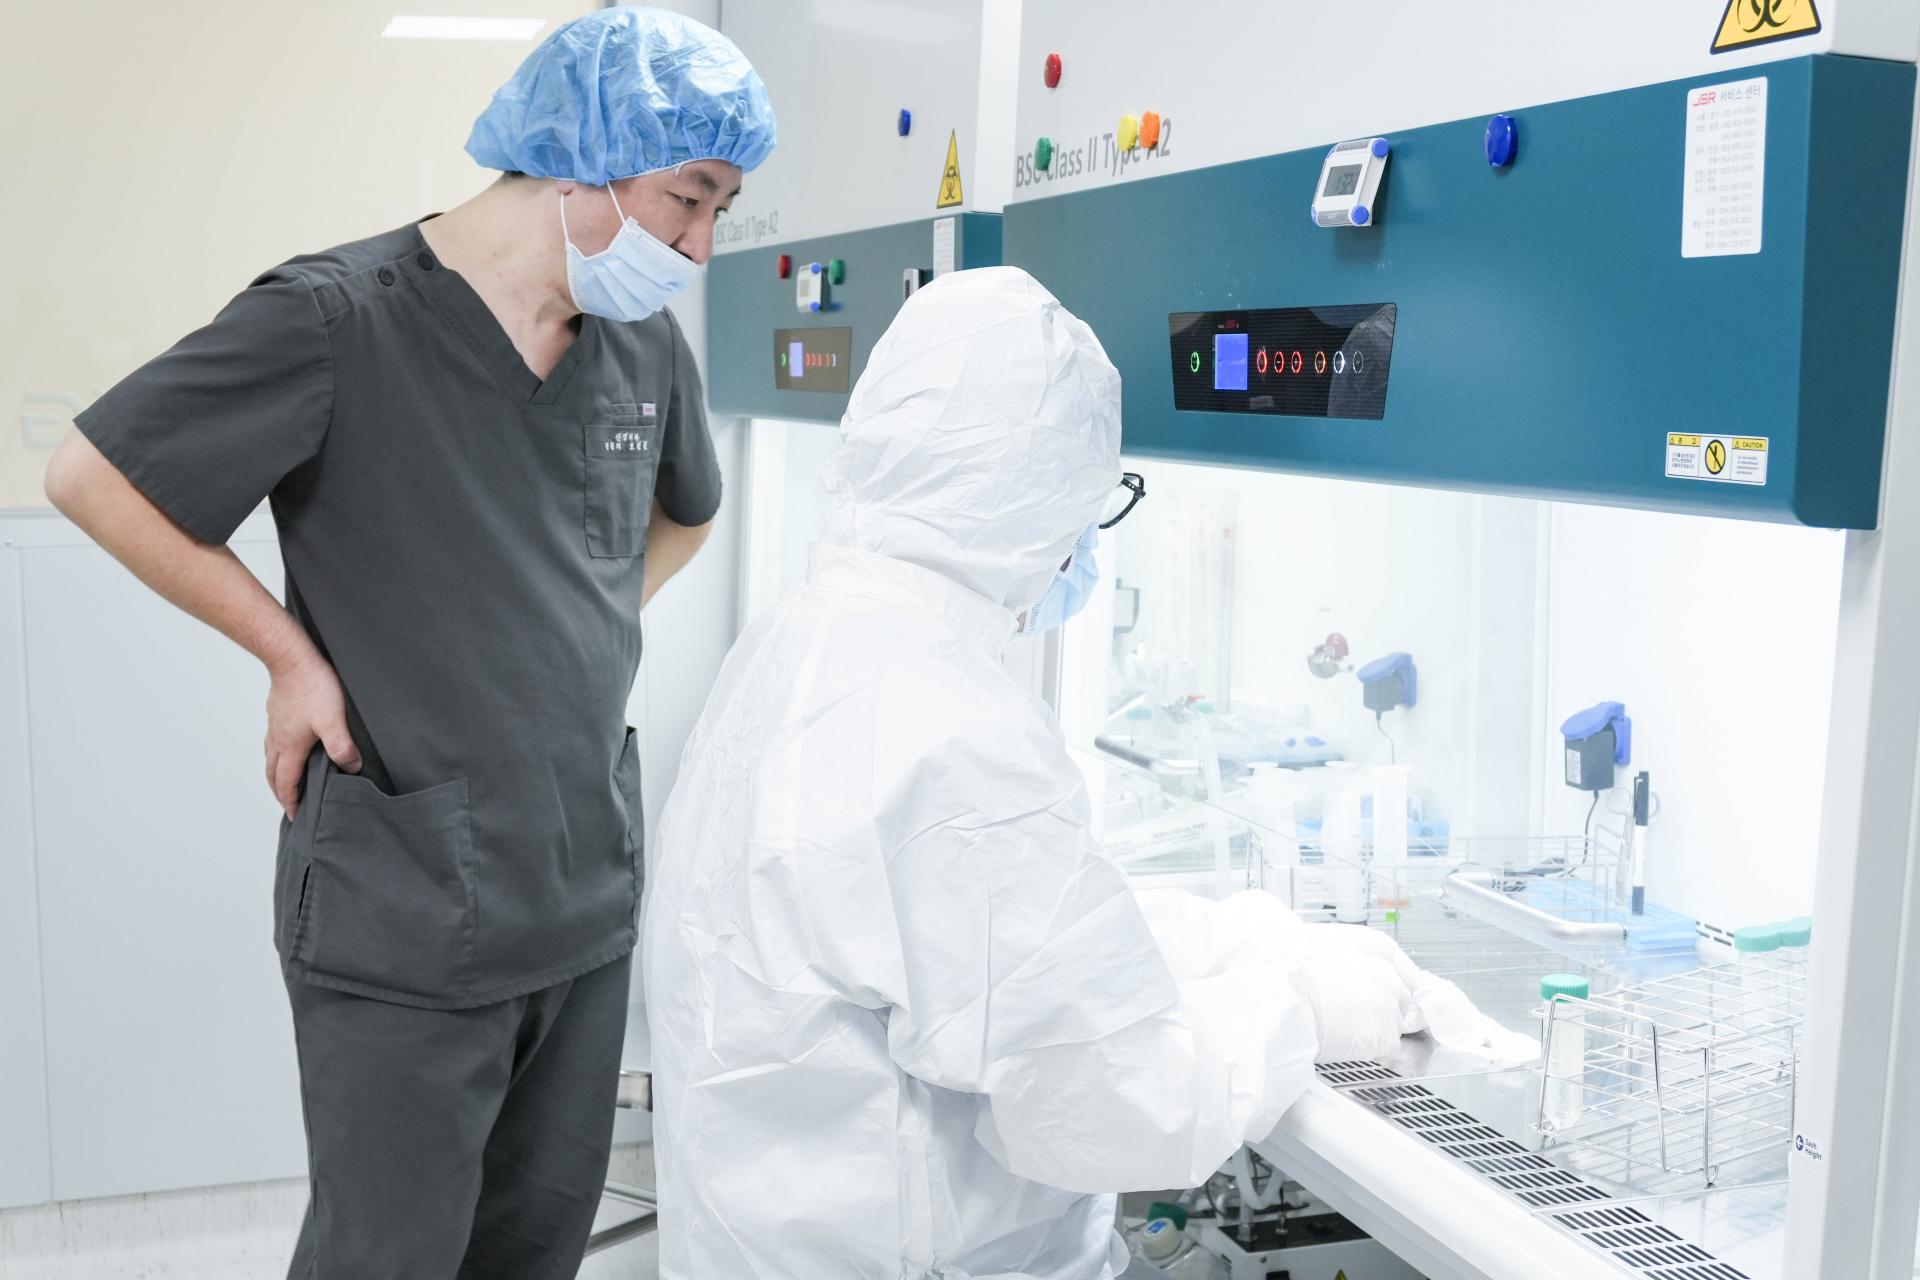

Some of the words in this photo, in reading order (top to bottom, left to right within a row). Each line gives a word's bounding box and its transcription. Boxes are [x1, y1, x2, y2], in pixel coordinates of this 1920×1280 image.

[1693, 91, 1716, 107] JSR
[1720, 88, 1743, 105] 서비스
[1746, 84, 1761, 99] 센터
[1103, 133, 1140, 176] Type
[1742, 440, 1763, 449] CAUTION
